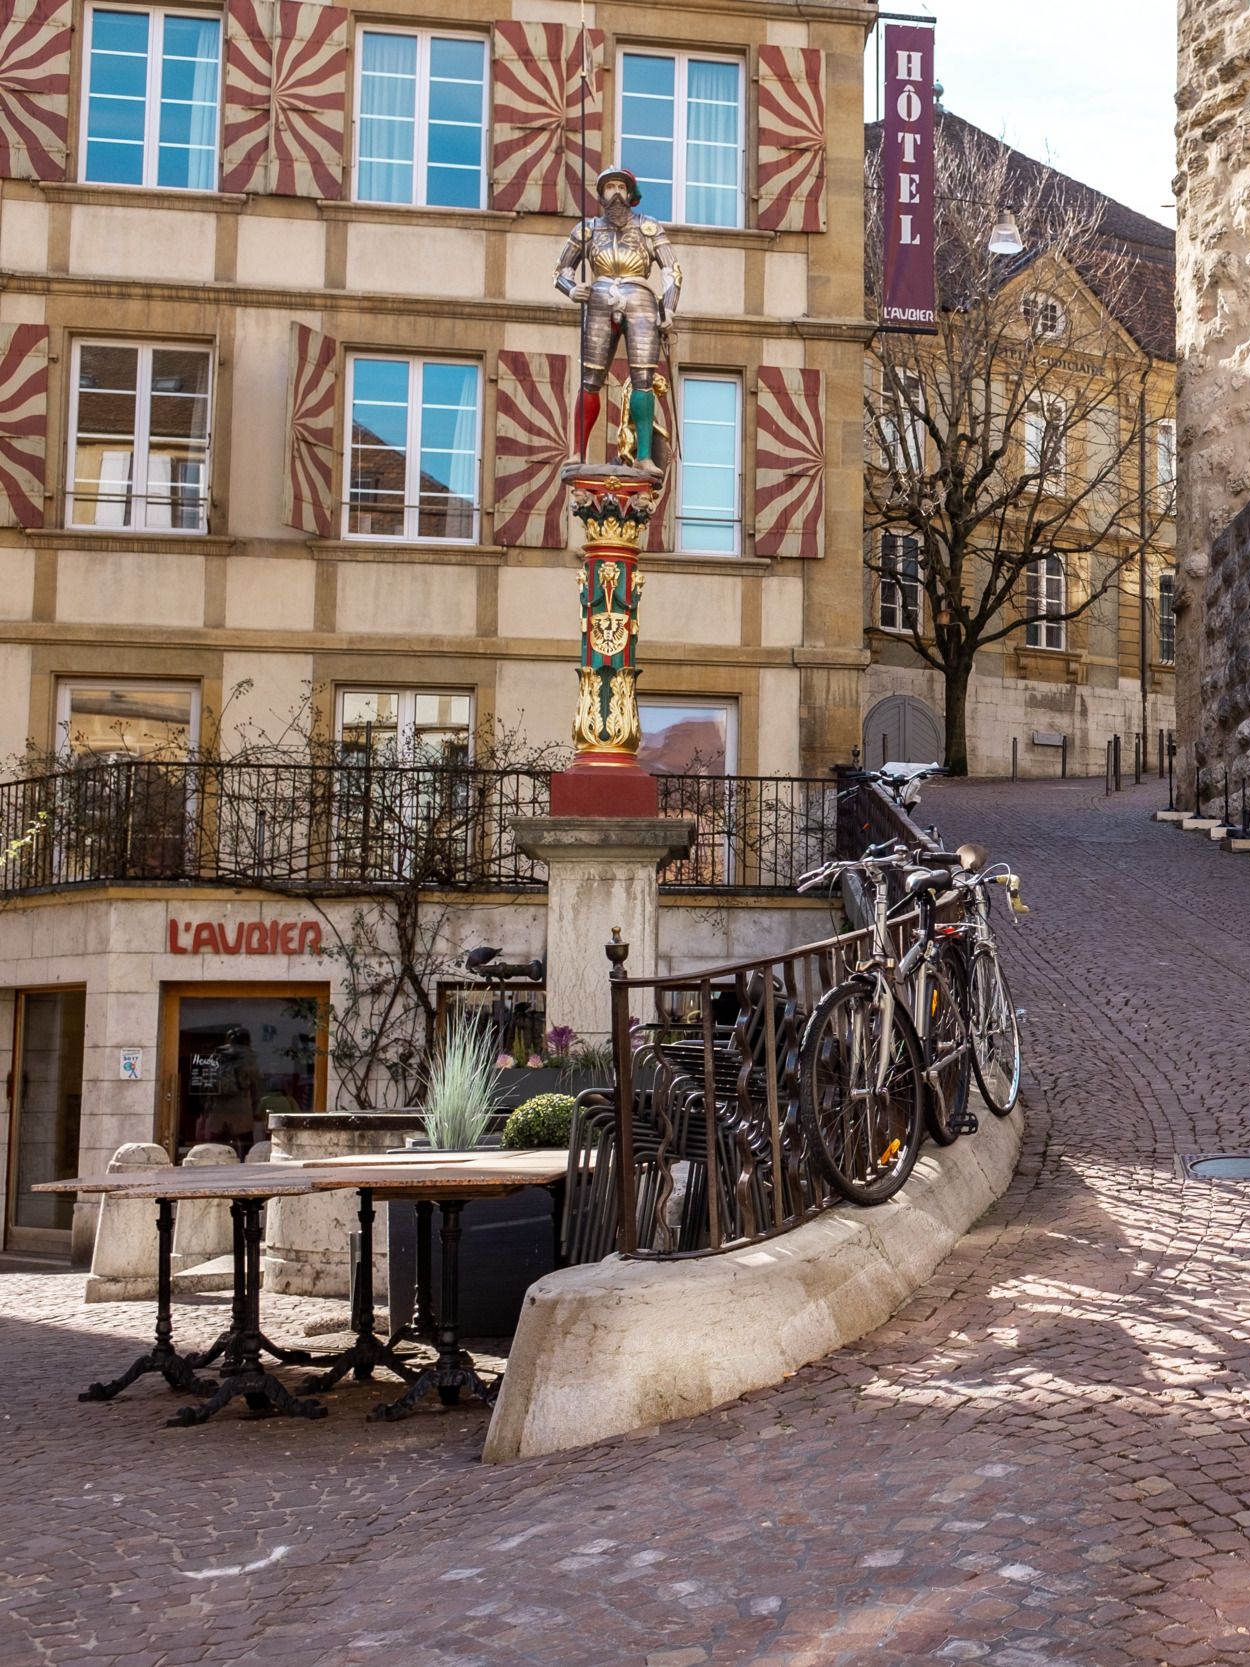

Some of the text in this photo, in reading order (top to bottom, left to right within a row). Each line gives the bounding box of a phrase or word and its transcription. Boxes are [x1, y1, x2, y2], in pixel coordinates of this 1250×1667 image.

[896, 50, 923, 245] HÔTEL
[884, 306, 934, 323] L'AUBIER
[169, 918, 323, 956] L'AUBIER
